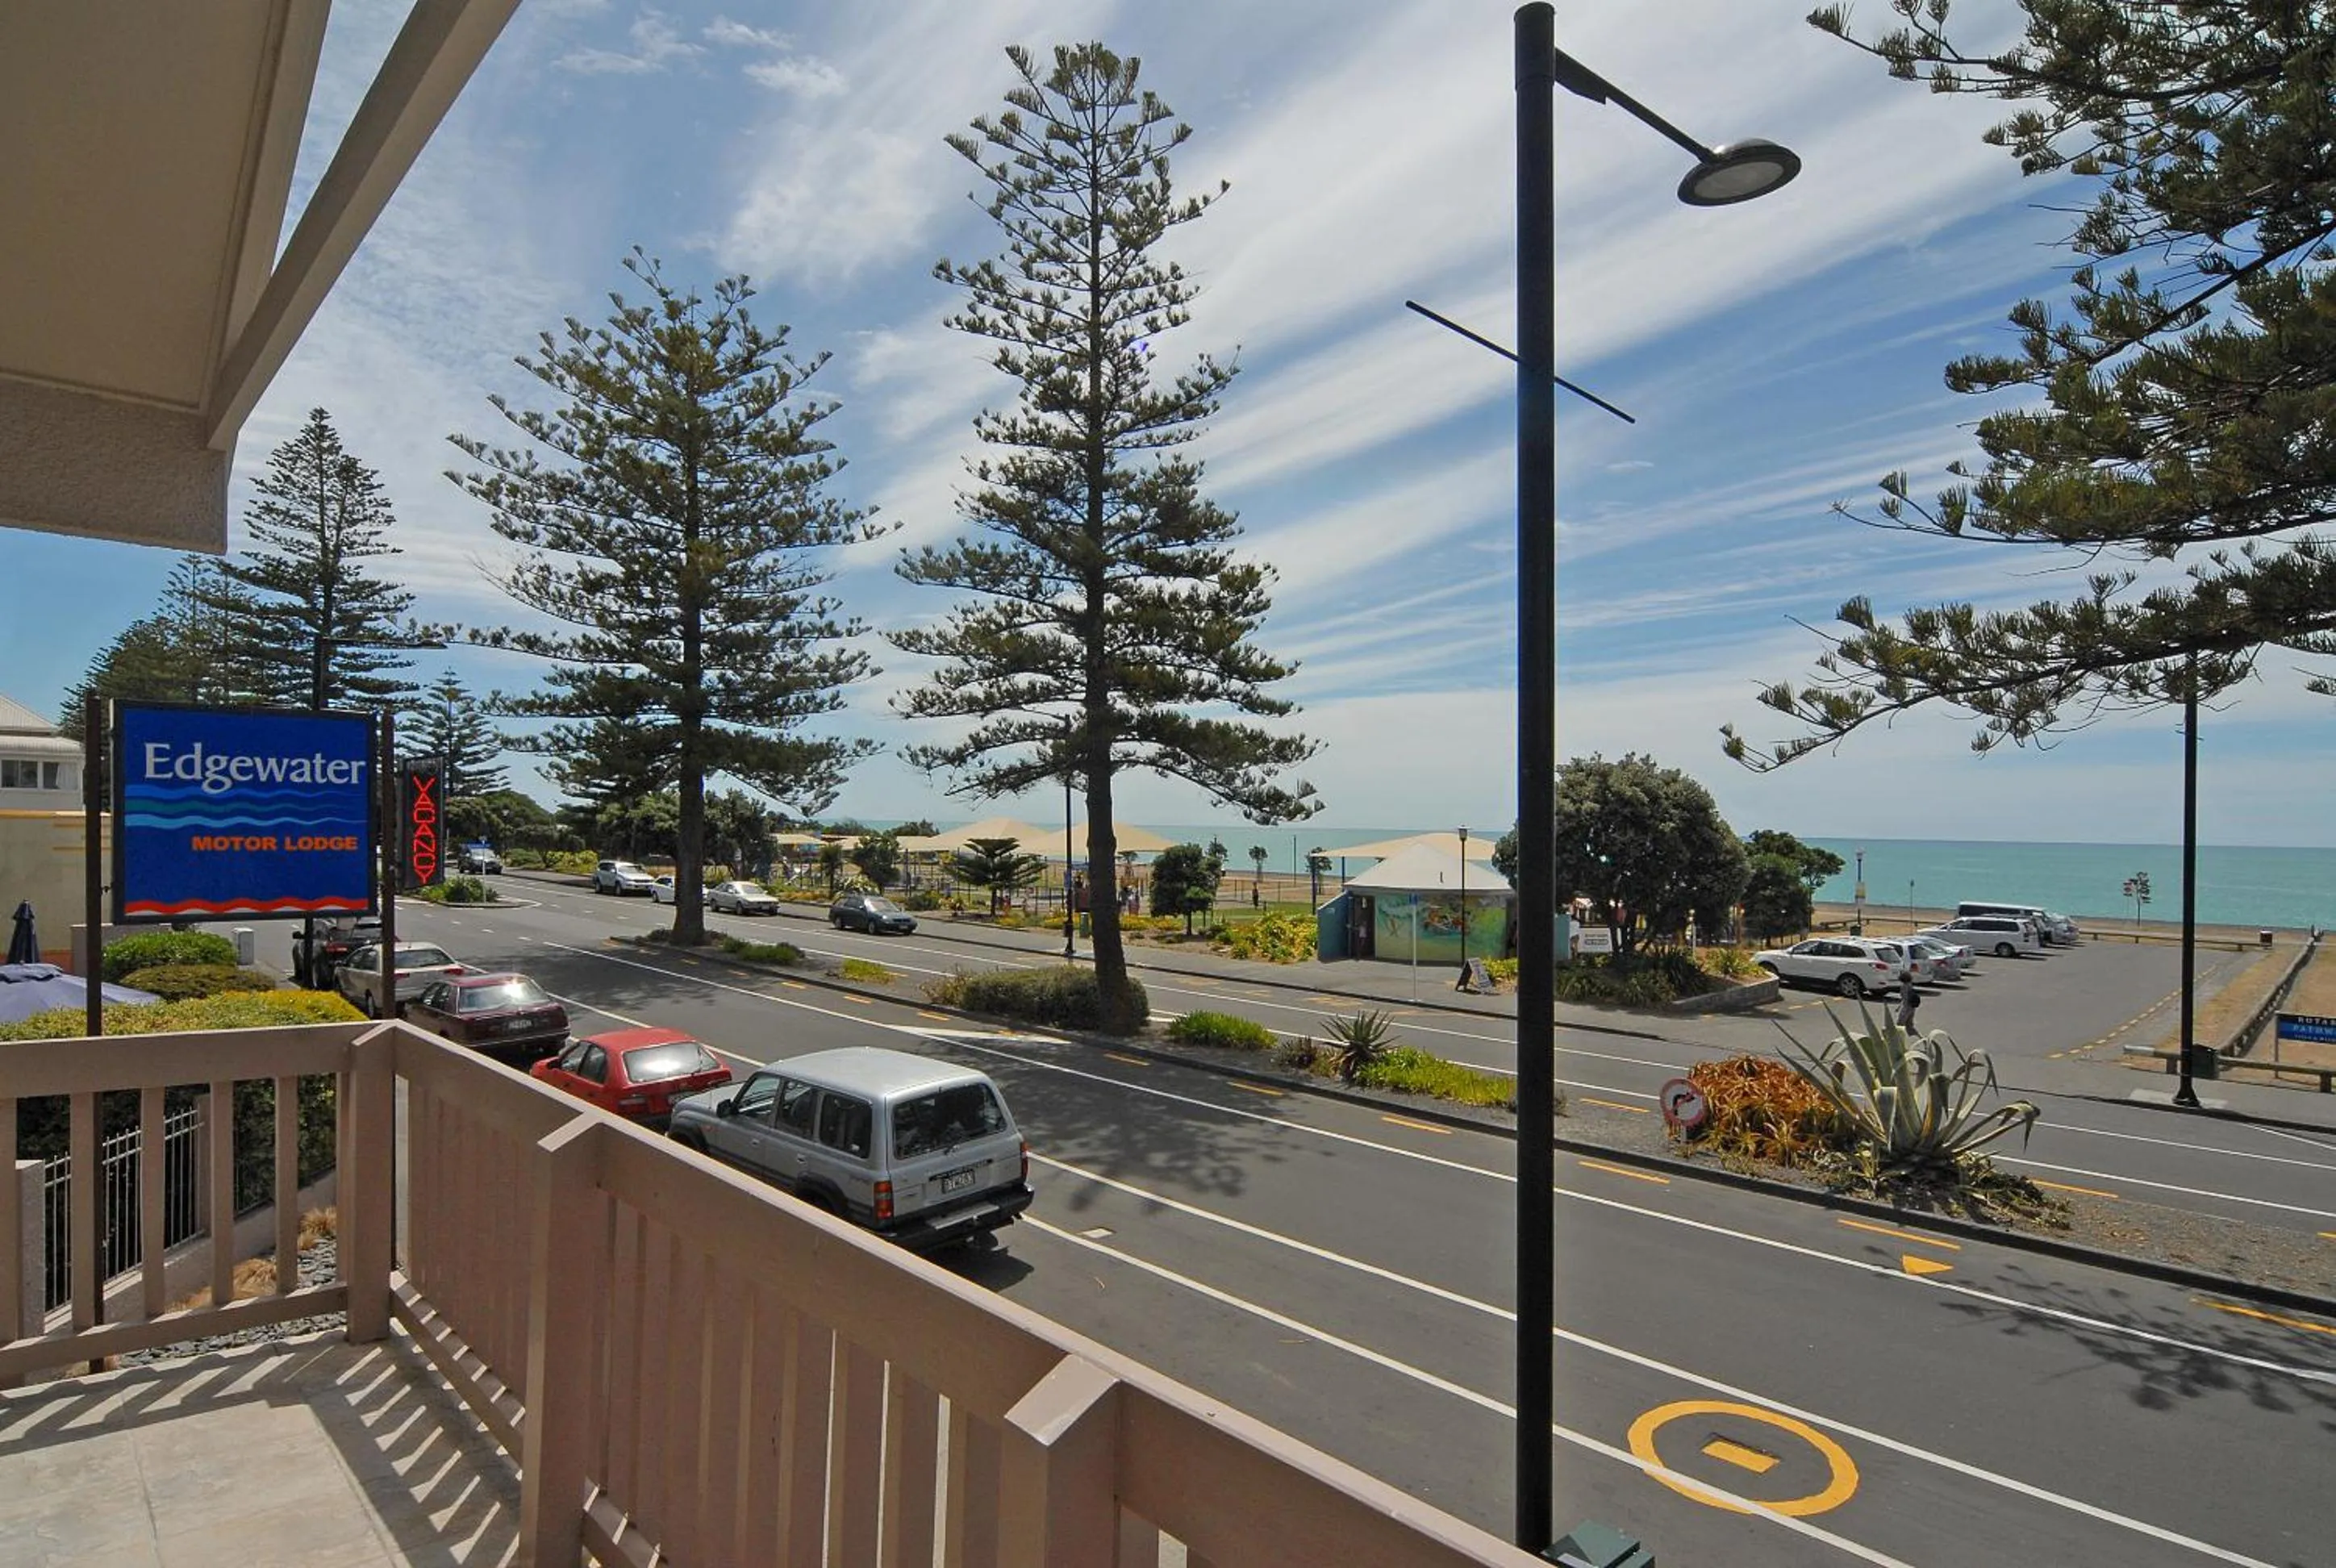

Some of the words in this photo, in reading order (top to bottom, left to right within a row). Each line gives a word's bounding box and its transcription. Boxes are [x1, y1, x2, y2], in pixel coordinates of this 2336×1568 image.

[144, 742, 366, 794] Edgewater
[191, 836, 276, 851] MOTOR
[284, 836, 359, 851] LODGE
[412, 774, 436, 884] VACANCY
